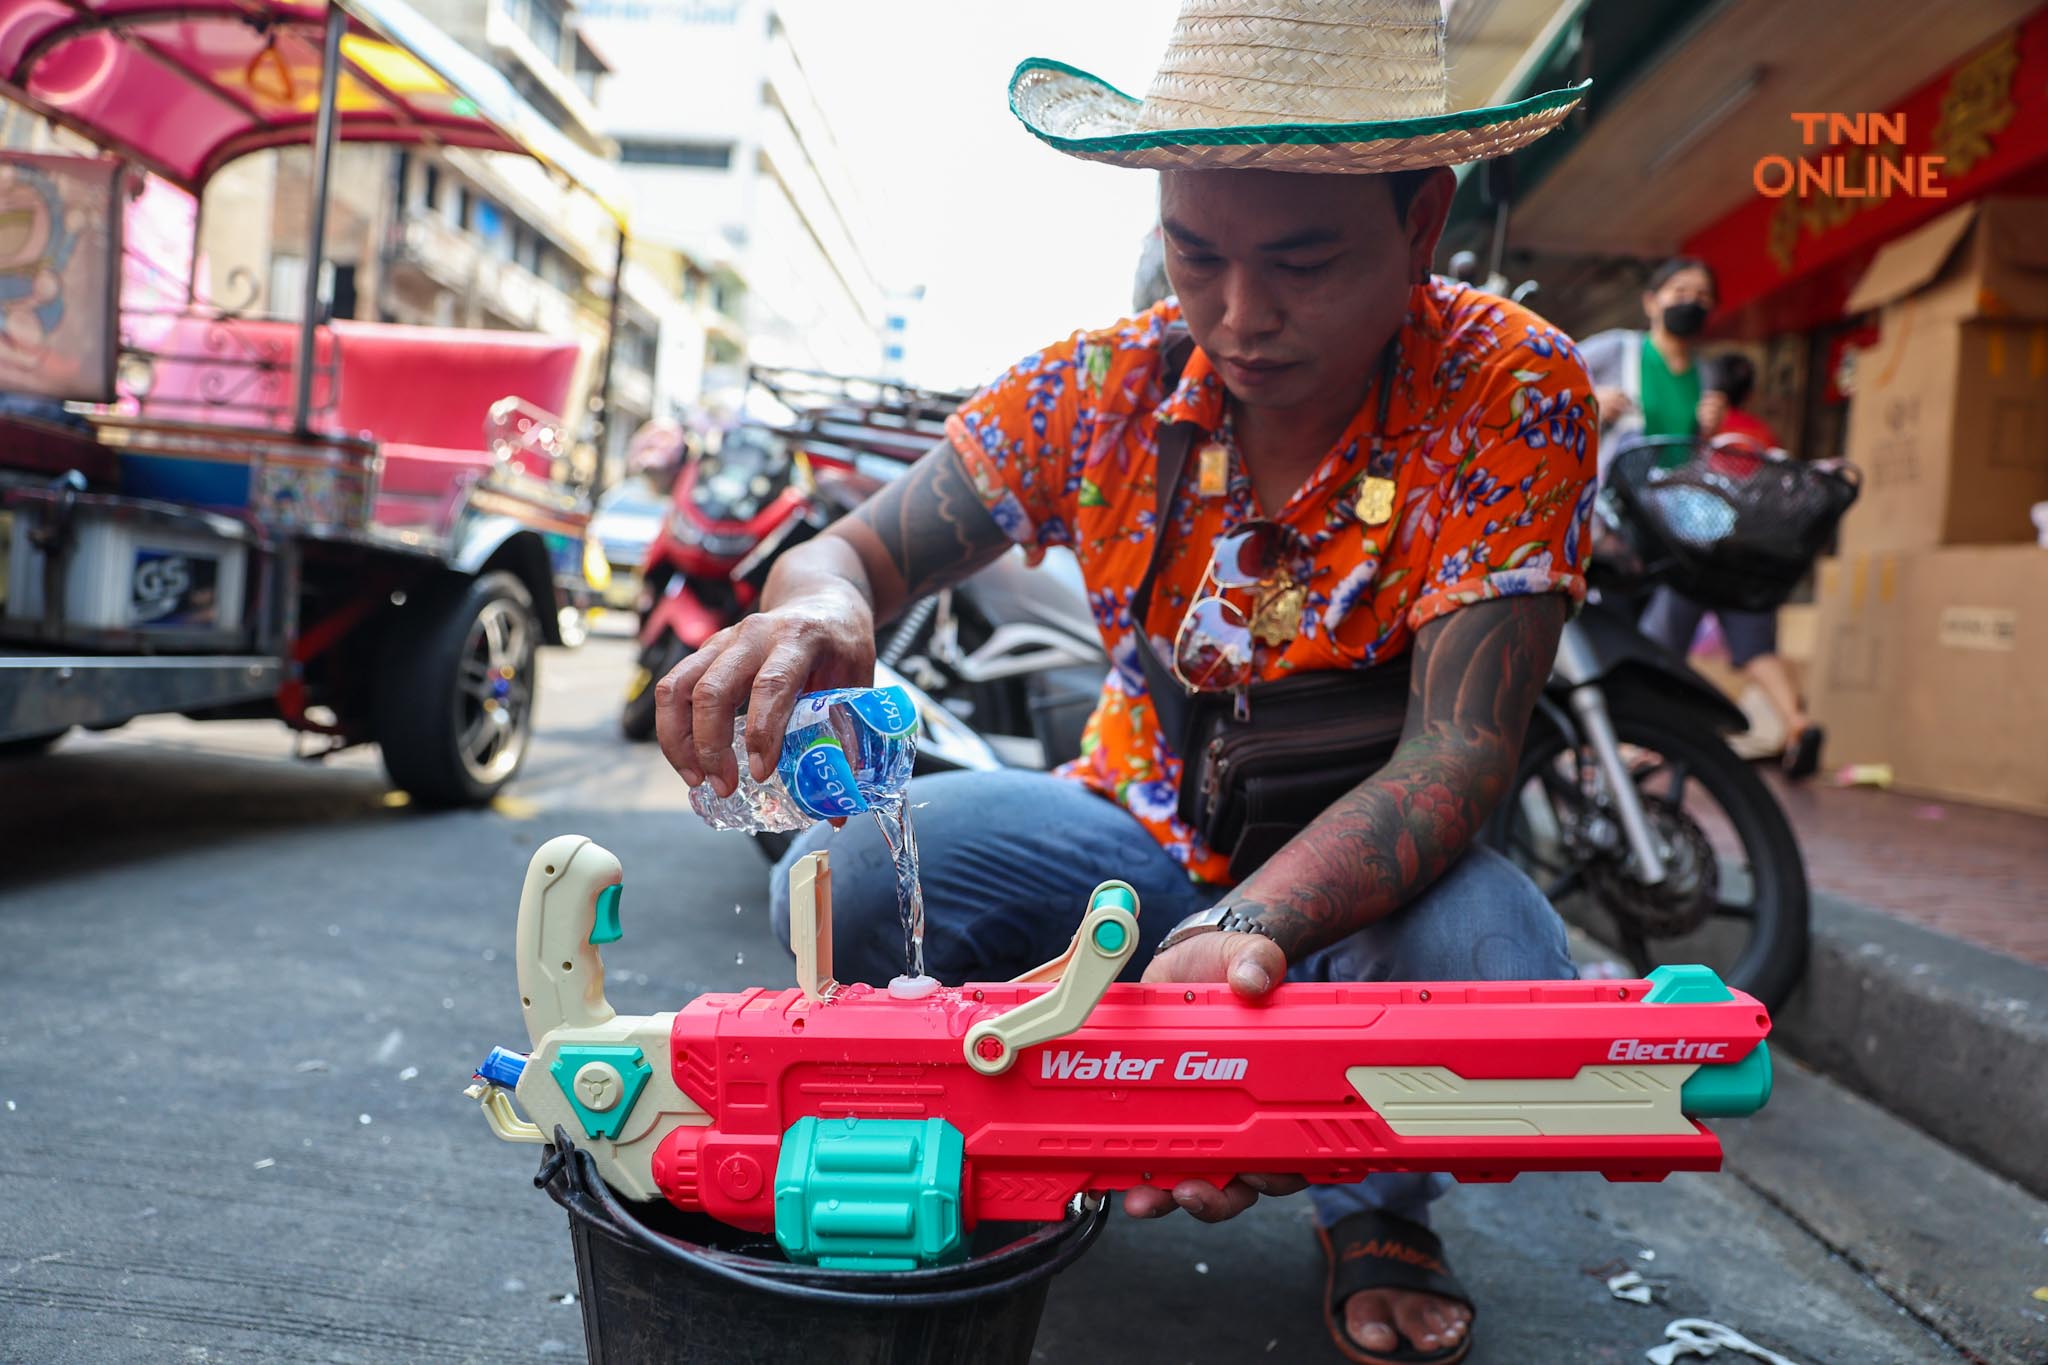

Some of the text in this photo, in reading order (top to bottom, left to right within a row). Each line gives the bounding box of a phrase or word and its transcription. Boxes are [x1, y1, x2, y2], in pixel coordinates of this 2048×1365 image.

[1607, 1039, 1729, 1061] Electric
[1041, 1050, 1249, 1081] Water Gun
